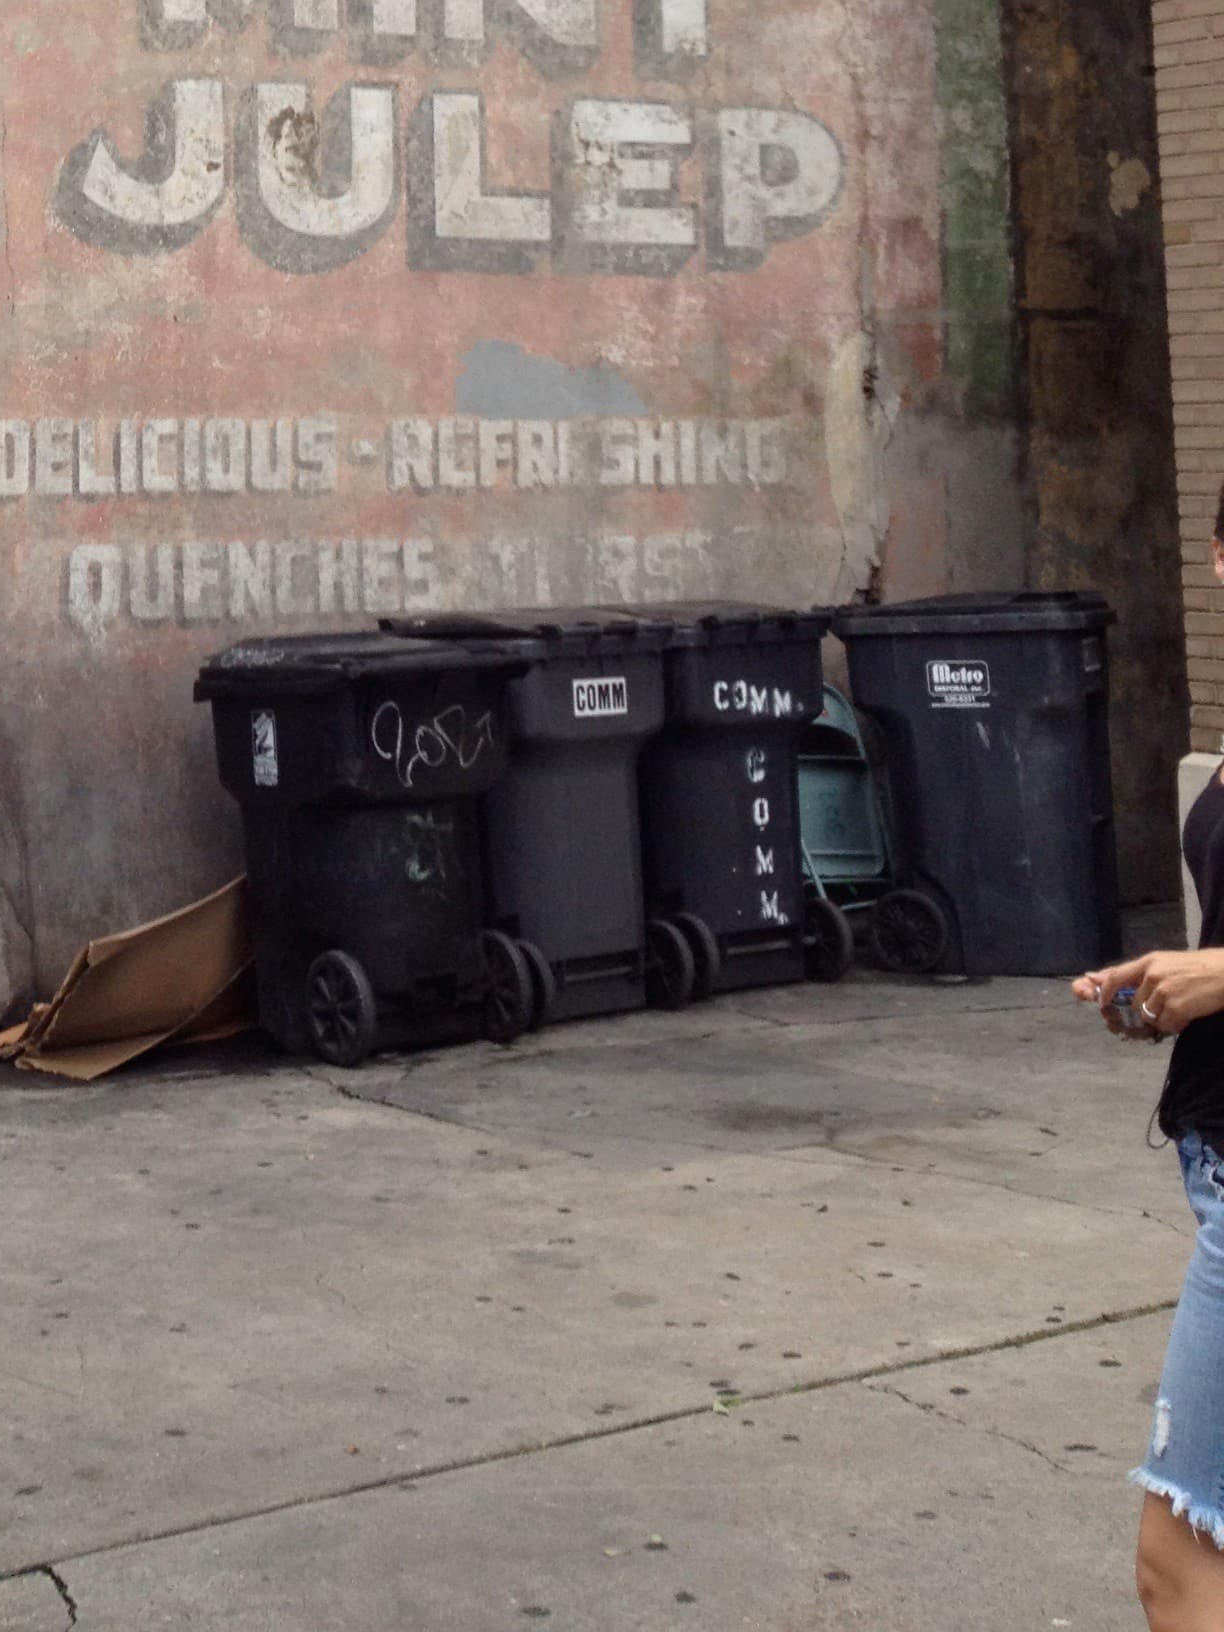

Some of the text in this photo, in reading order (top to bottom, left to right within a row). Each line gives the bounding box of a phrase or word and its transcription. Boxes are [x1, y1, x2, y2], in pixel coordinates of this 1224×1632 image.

[64, 77, 843, 263] JULEP
[69, 538, 441, 633] QUENCHES
[575, 682, 625, 712] COMM
